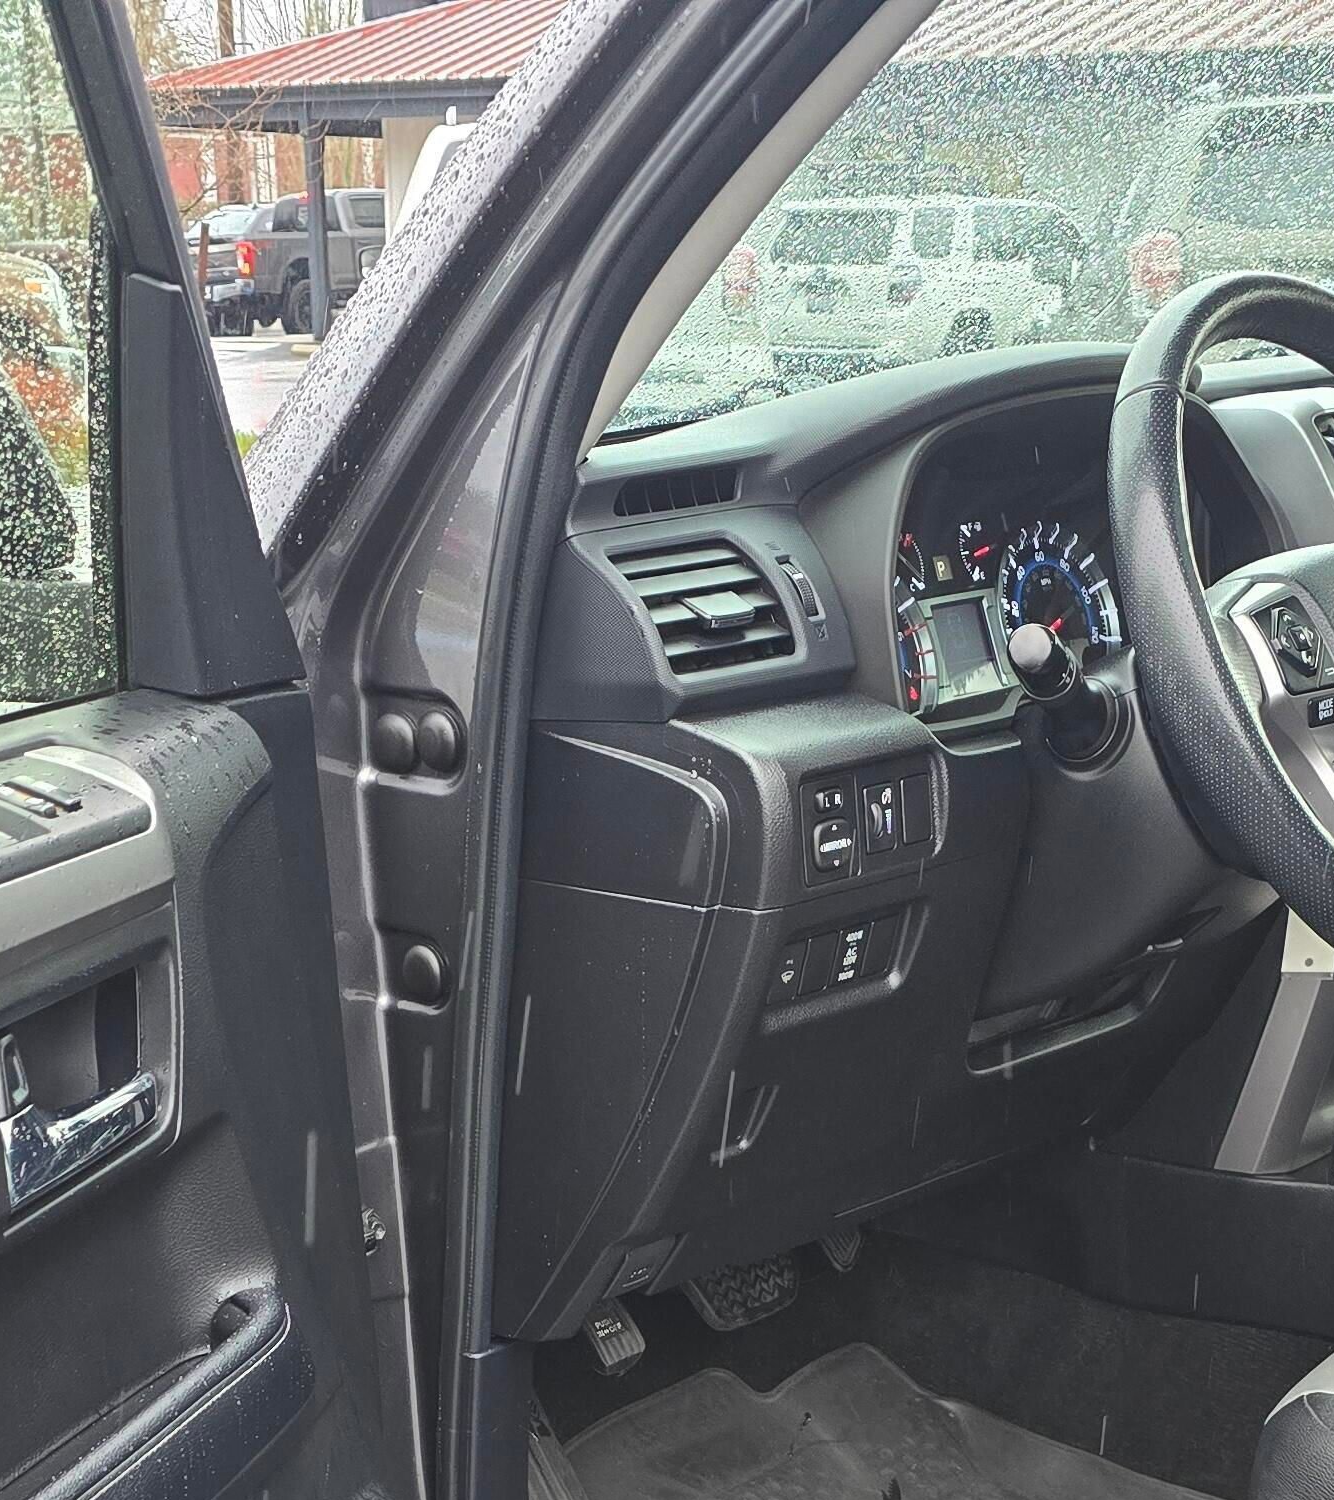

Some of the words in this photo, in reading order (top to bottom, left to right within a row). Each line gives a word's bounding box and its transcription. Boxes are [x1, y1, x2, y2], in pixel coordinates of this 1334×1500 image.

[937, 560, 945, 578] P
[1080, 585, 1092, 605] 100
[1319, 697, 1334, 710] MODE
[825, 796, 830, 808] L
[834, 793, 842, 805] R
[846, 947, 858, 957] AC
